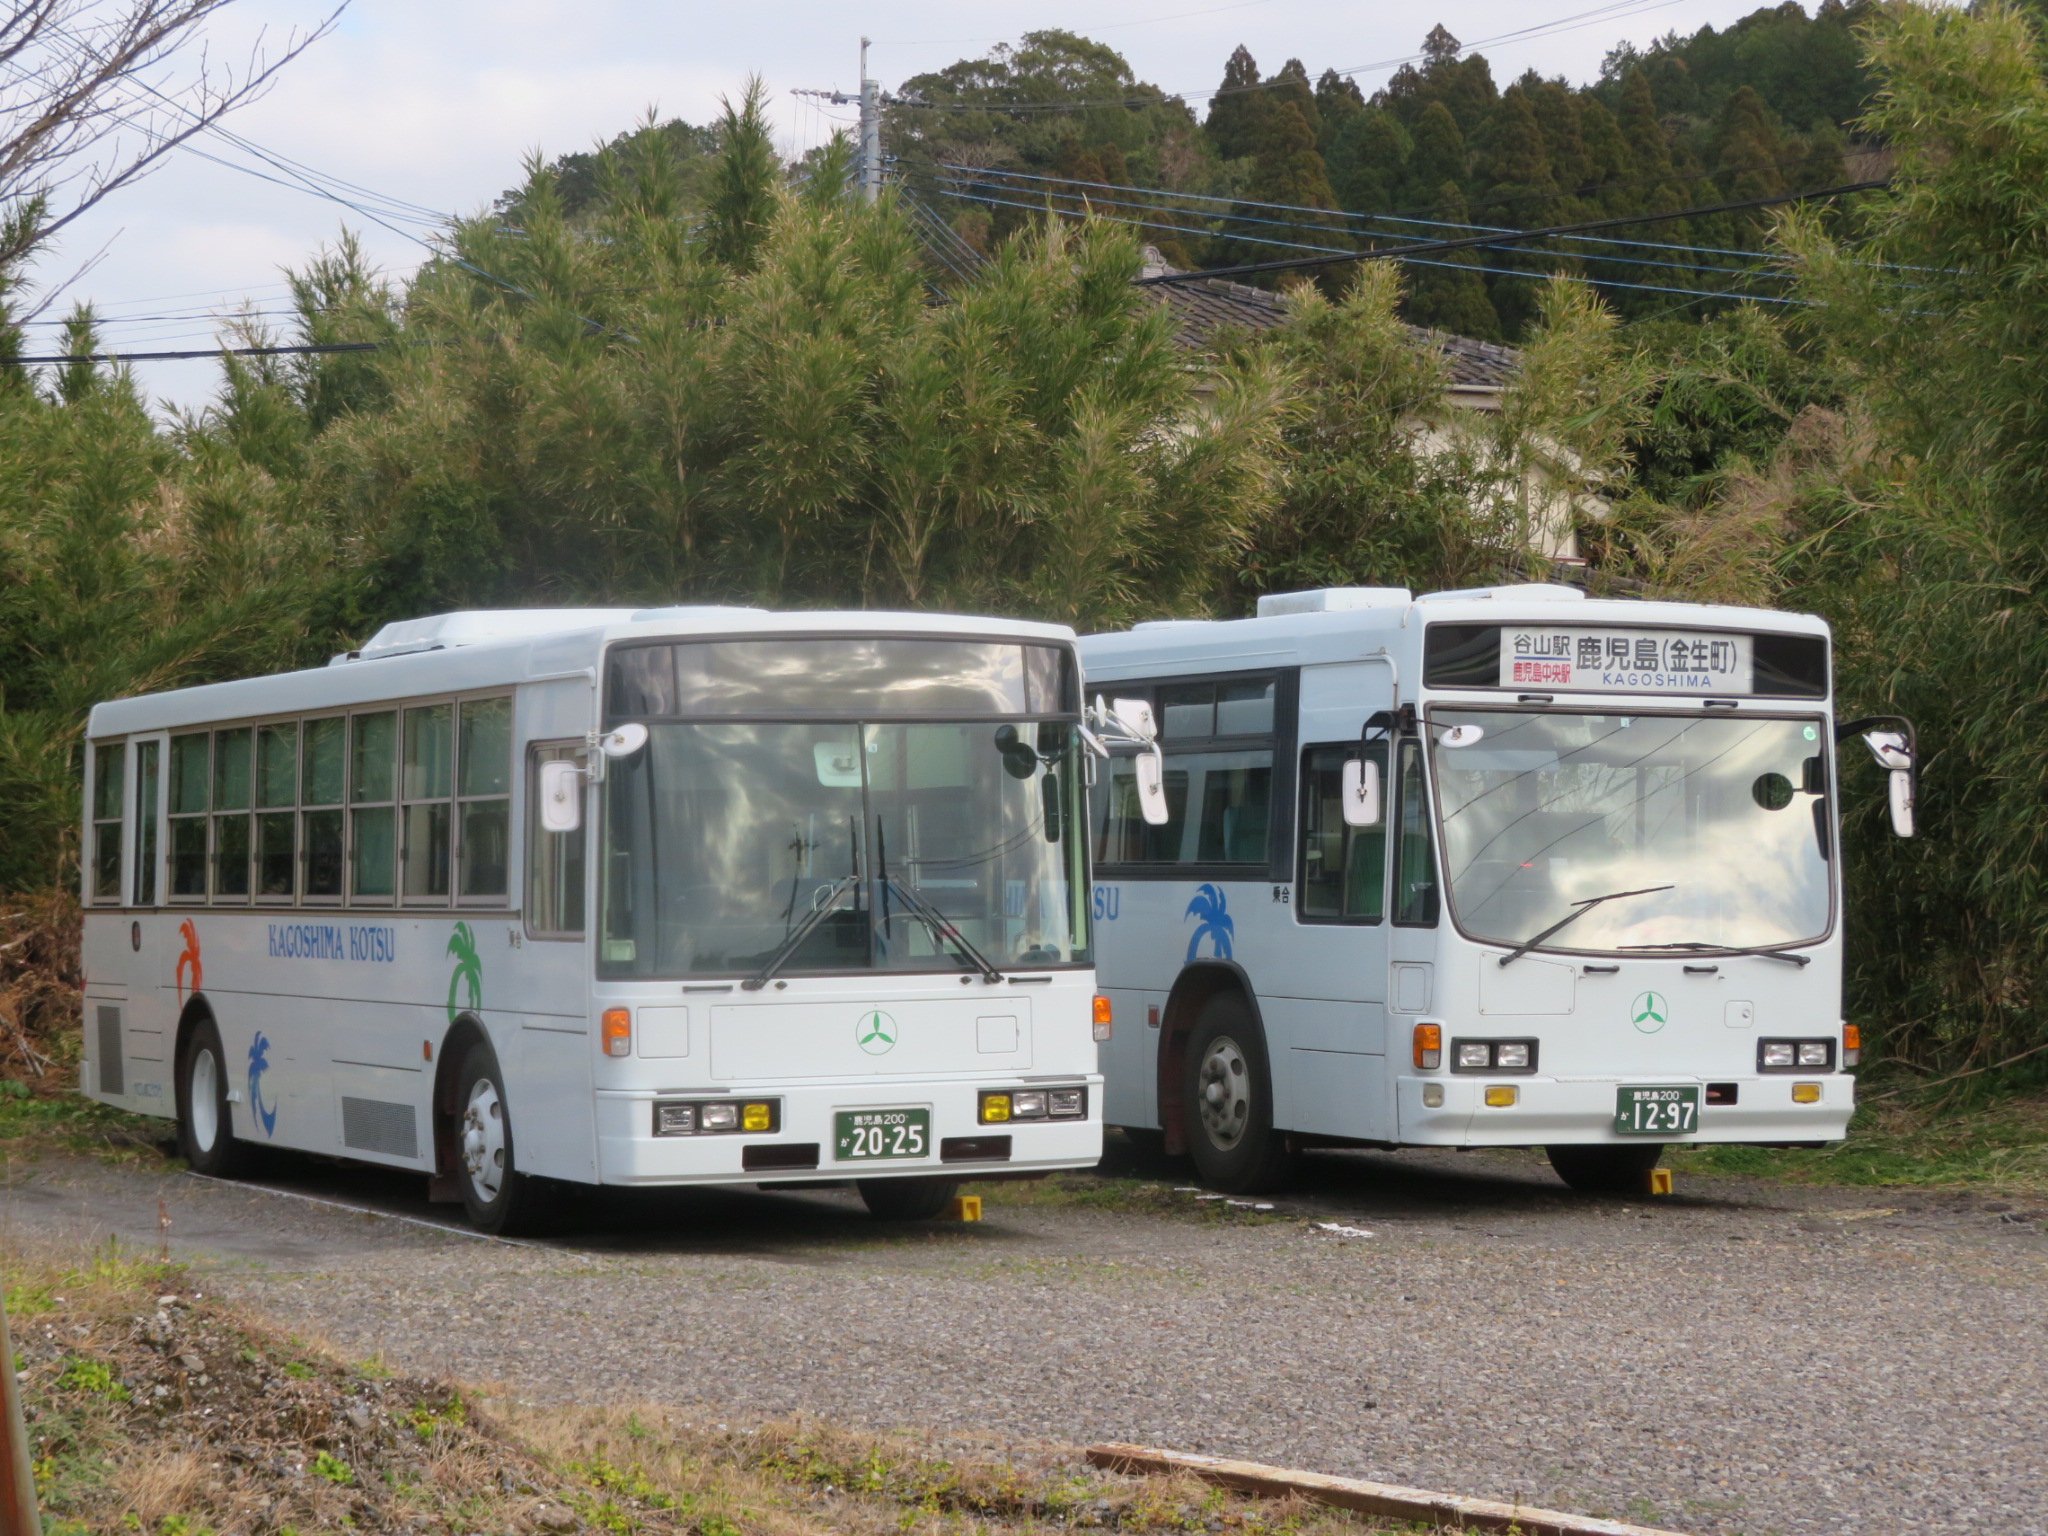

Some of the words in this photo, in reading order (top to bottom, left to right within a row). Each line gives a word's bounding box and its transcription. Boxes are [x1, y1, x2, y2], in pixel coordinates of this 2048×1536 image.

[1514, 634, 1571, 656] 谷山駅
[1513, 661, 1571, 684] 鹿児島中央駅
[1602, 672, 1712, 688] KAGOSHIMA
[268, 924, 345, 960] KAGOSHIMA
[349, 926, 395, 962] KOTSU
[1634, 1102, 1695, 1130] 12-97
[851, 1124, 923, 1156] 20-25
